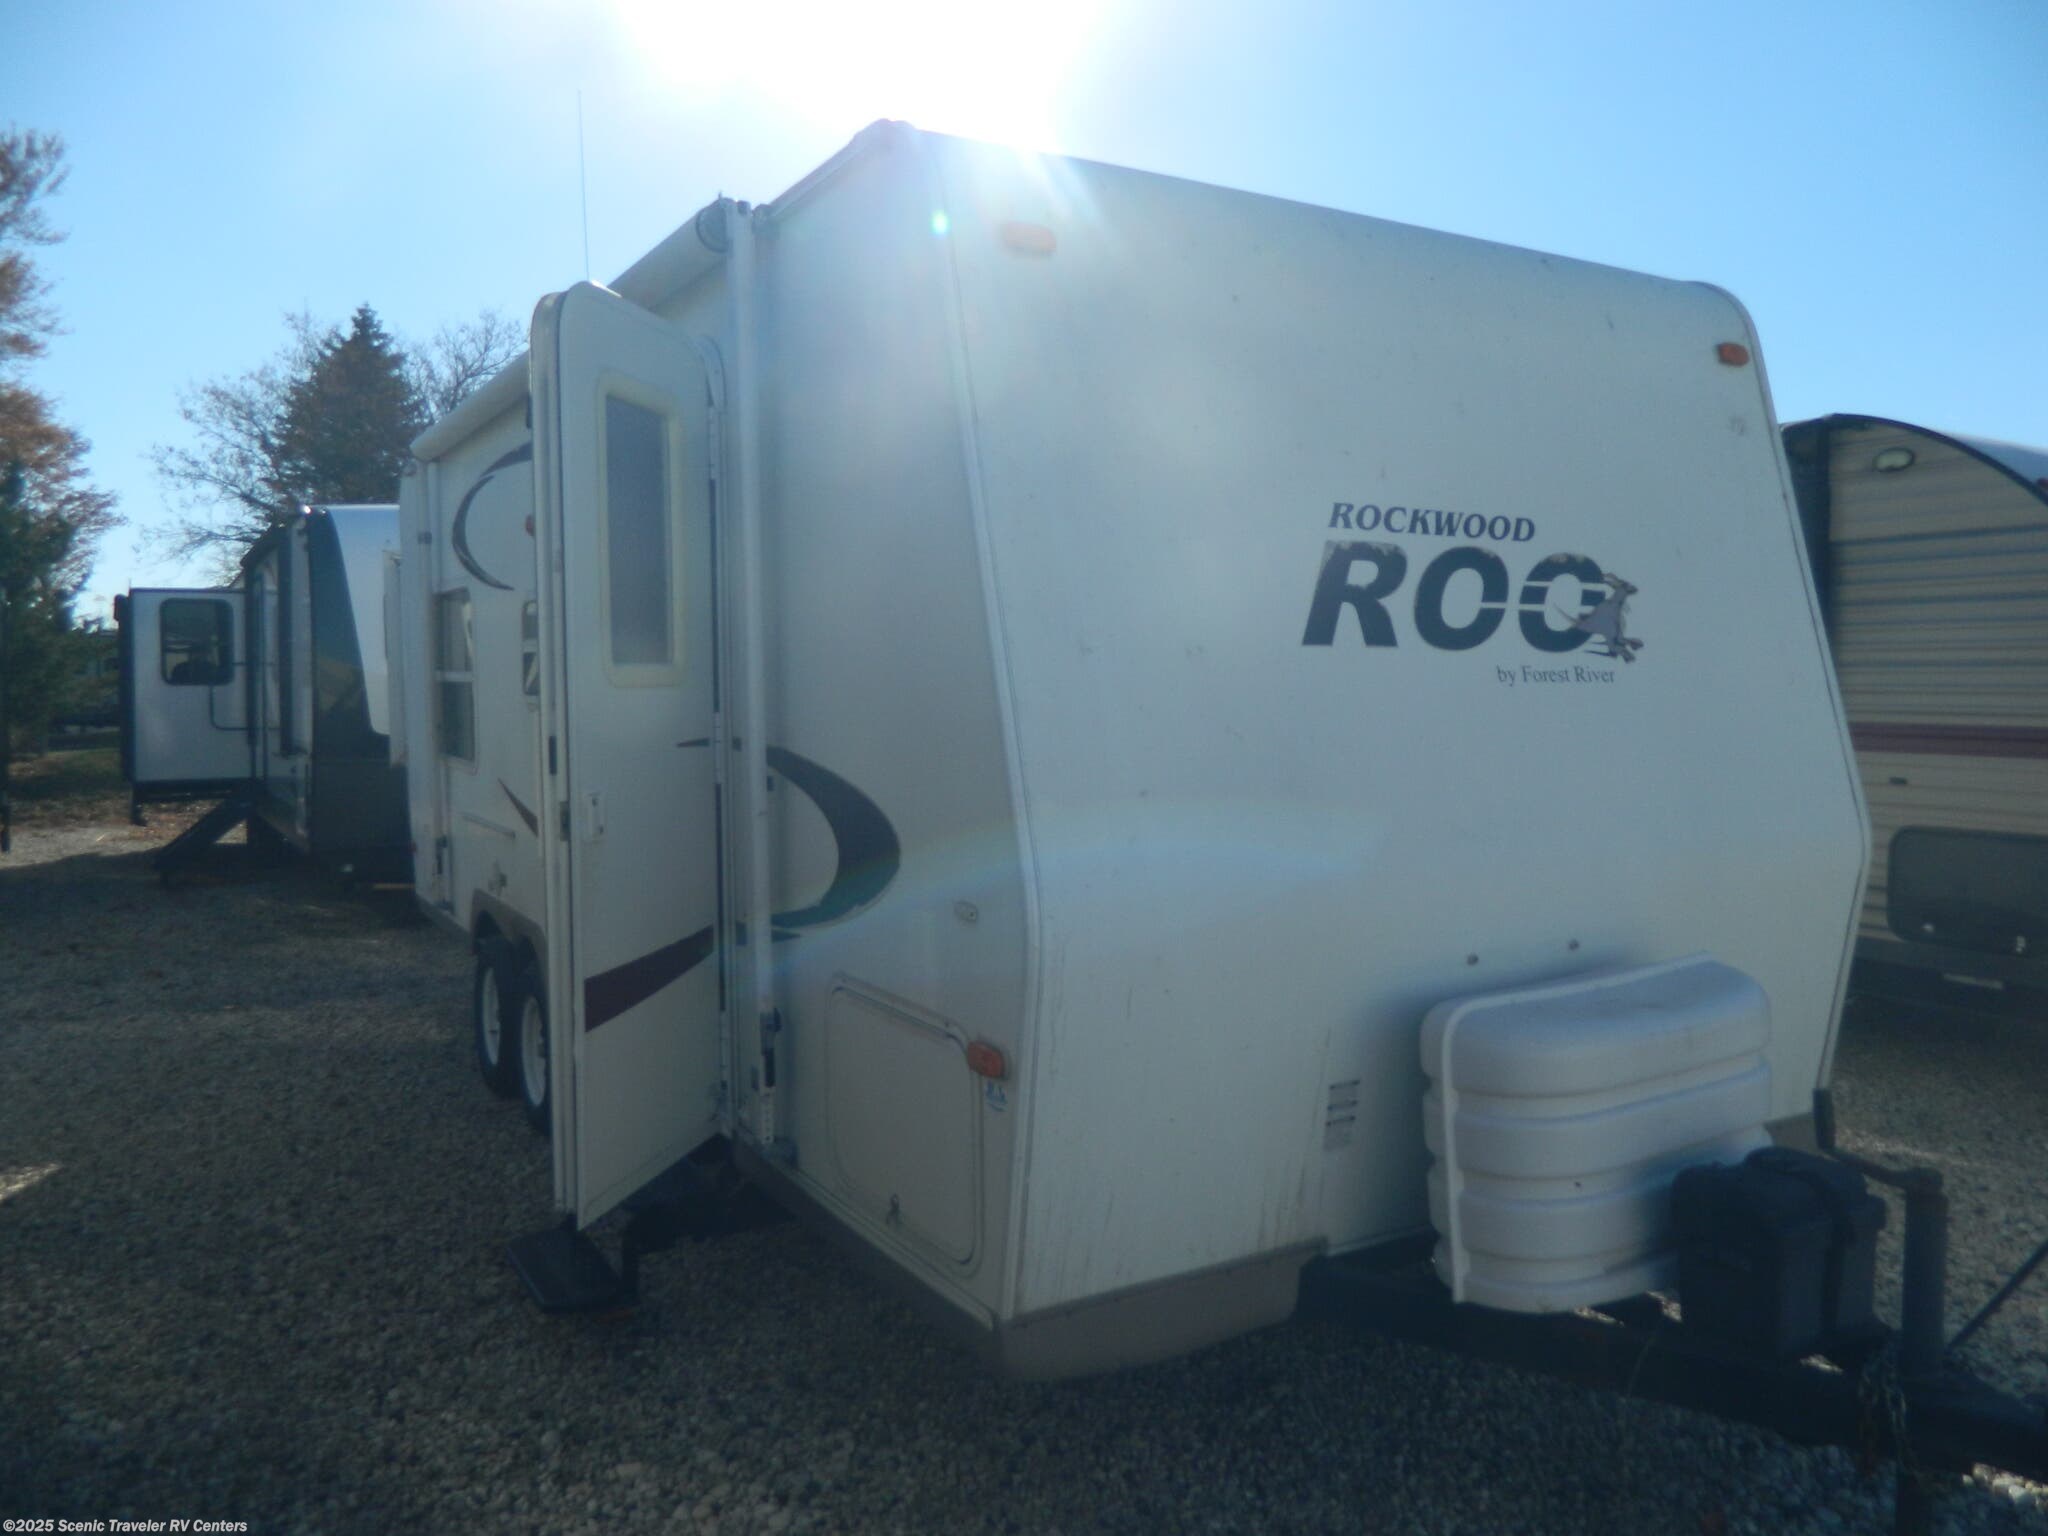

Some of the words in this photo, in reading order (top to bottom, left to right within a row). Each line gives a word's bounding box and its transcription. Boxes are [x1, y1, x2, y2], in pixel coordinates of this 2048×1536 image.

[1327, 502, 1535, 541] ROCKWOOD
[1301, 540, 1608, 652] ROO
[1496, 664, 1515, 687] by
[1521, 665, 1571, 684] Forest
[1574, 666, 1616, 685] River
